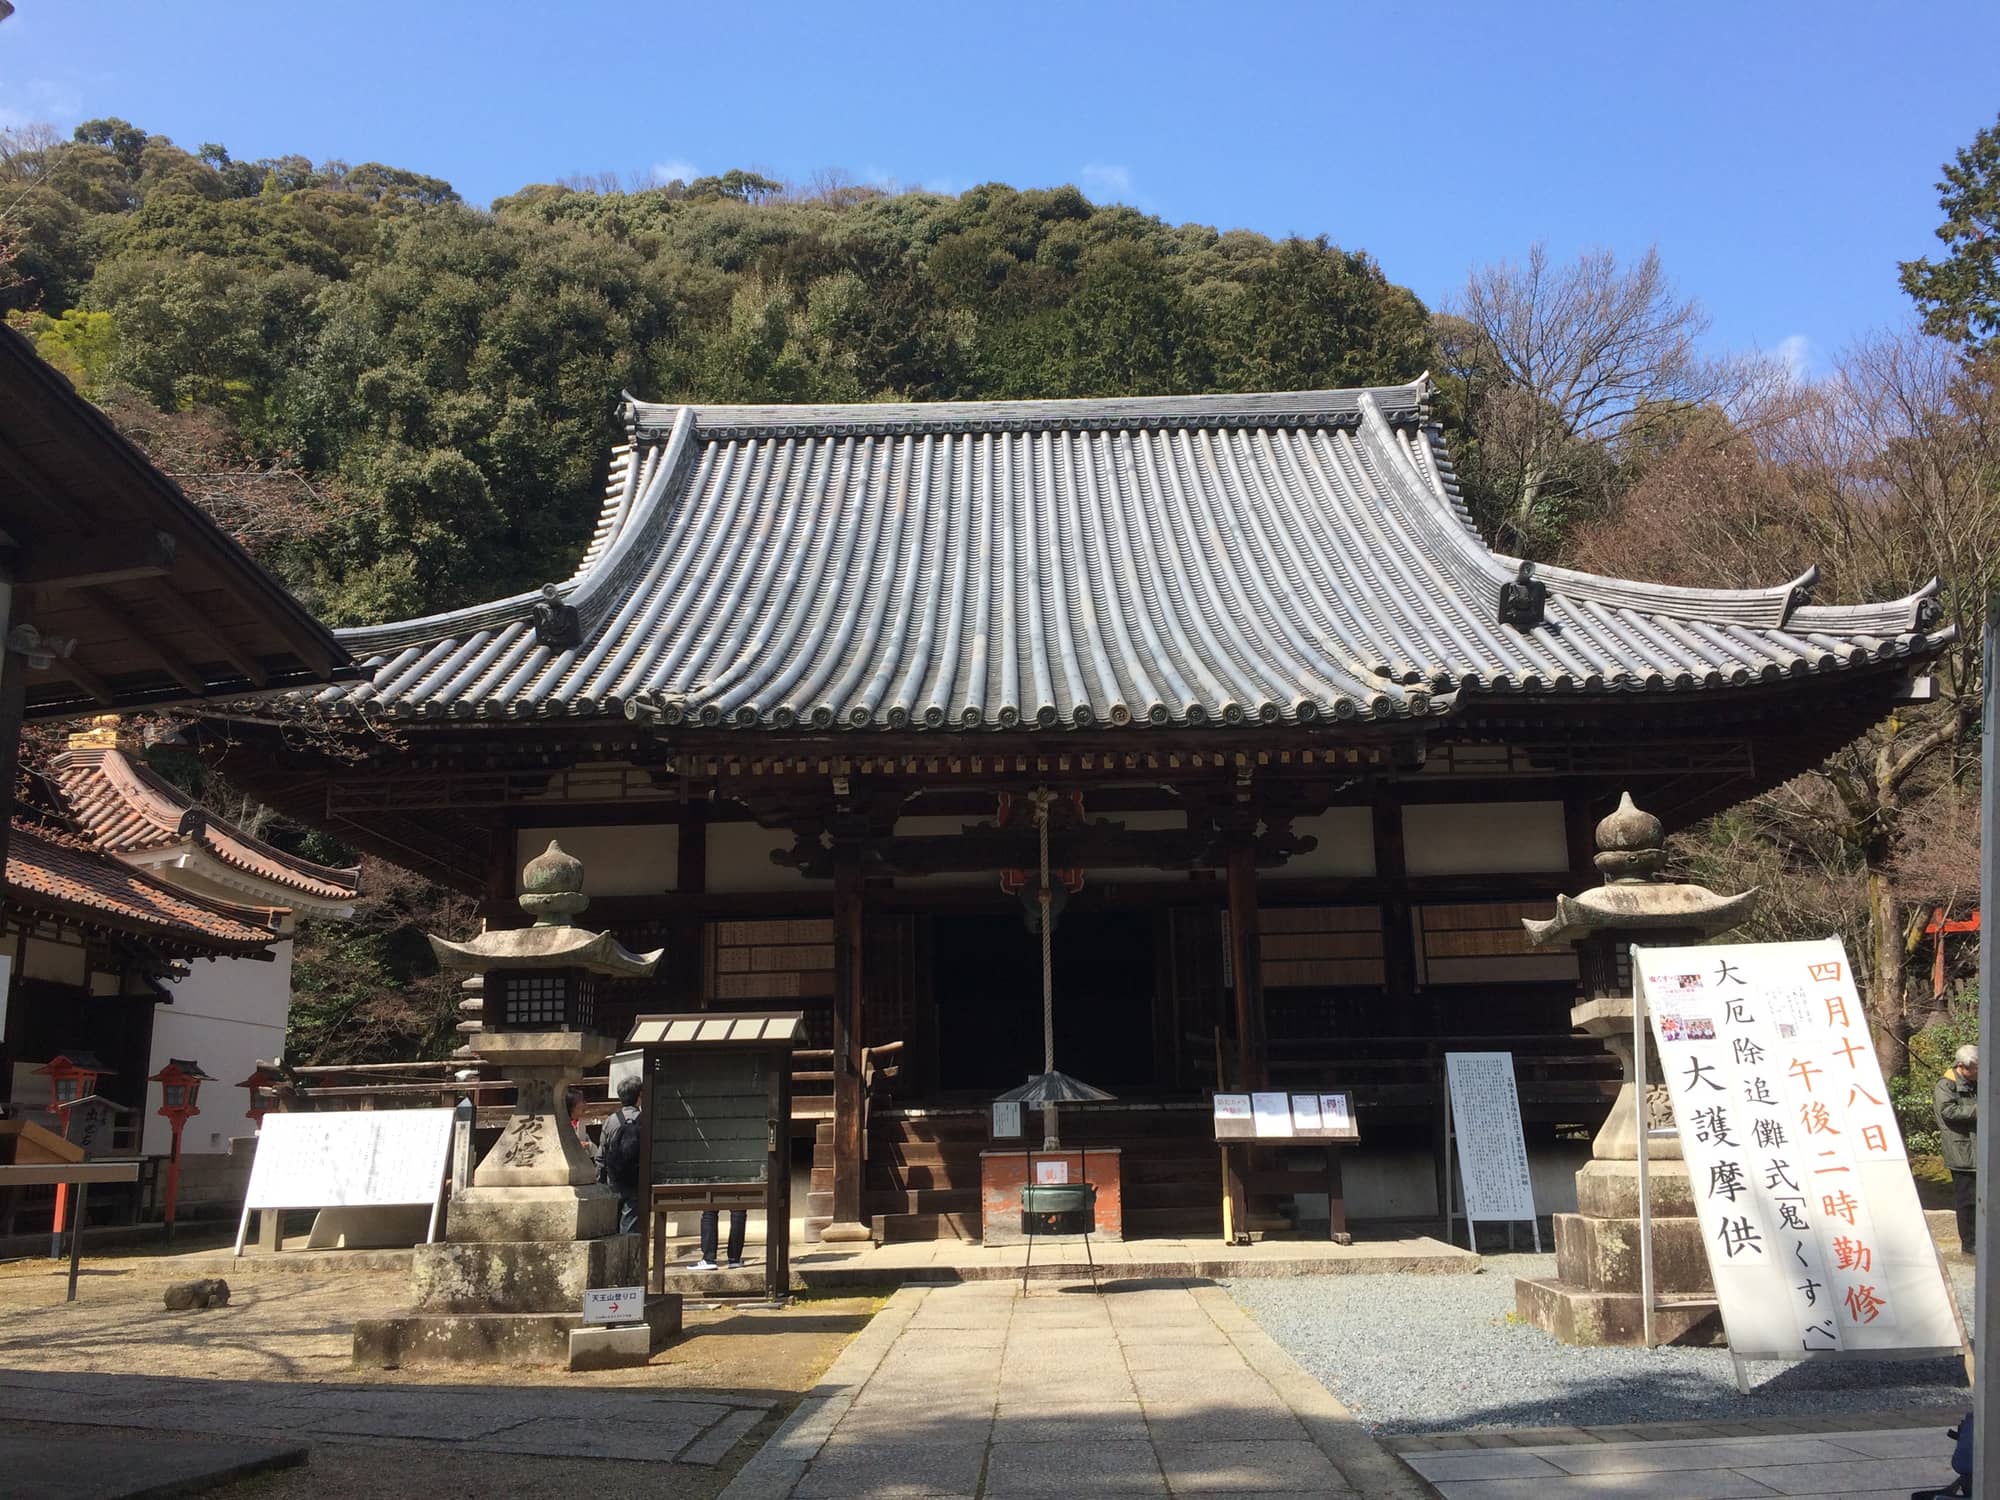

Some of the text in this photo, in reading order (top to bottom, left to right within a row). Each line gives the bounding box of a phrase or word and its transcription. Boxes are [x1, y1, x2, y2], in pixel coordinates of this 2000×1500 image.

[1683, 1054, 1762, 1259] 大護摩供
[1807, 960, 1889, 1154] 四月十八日
[1787, 1056, 1887, 1325] 午後二時勤修
[591, 1292, 637, 1302] 天王山登り口
